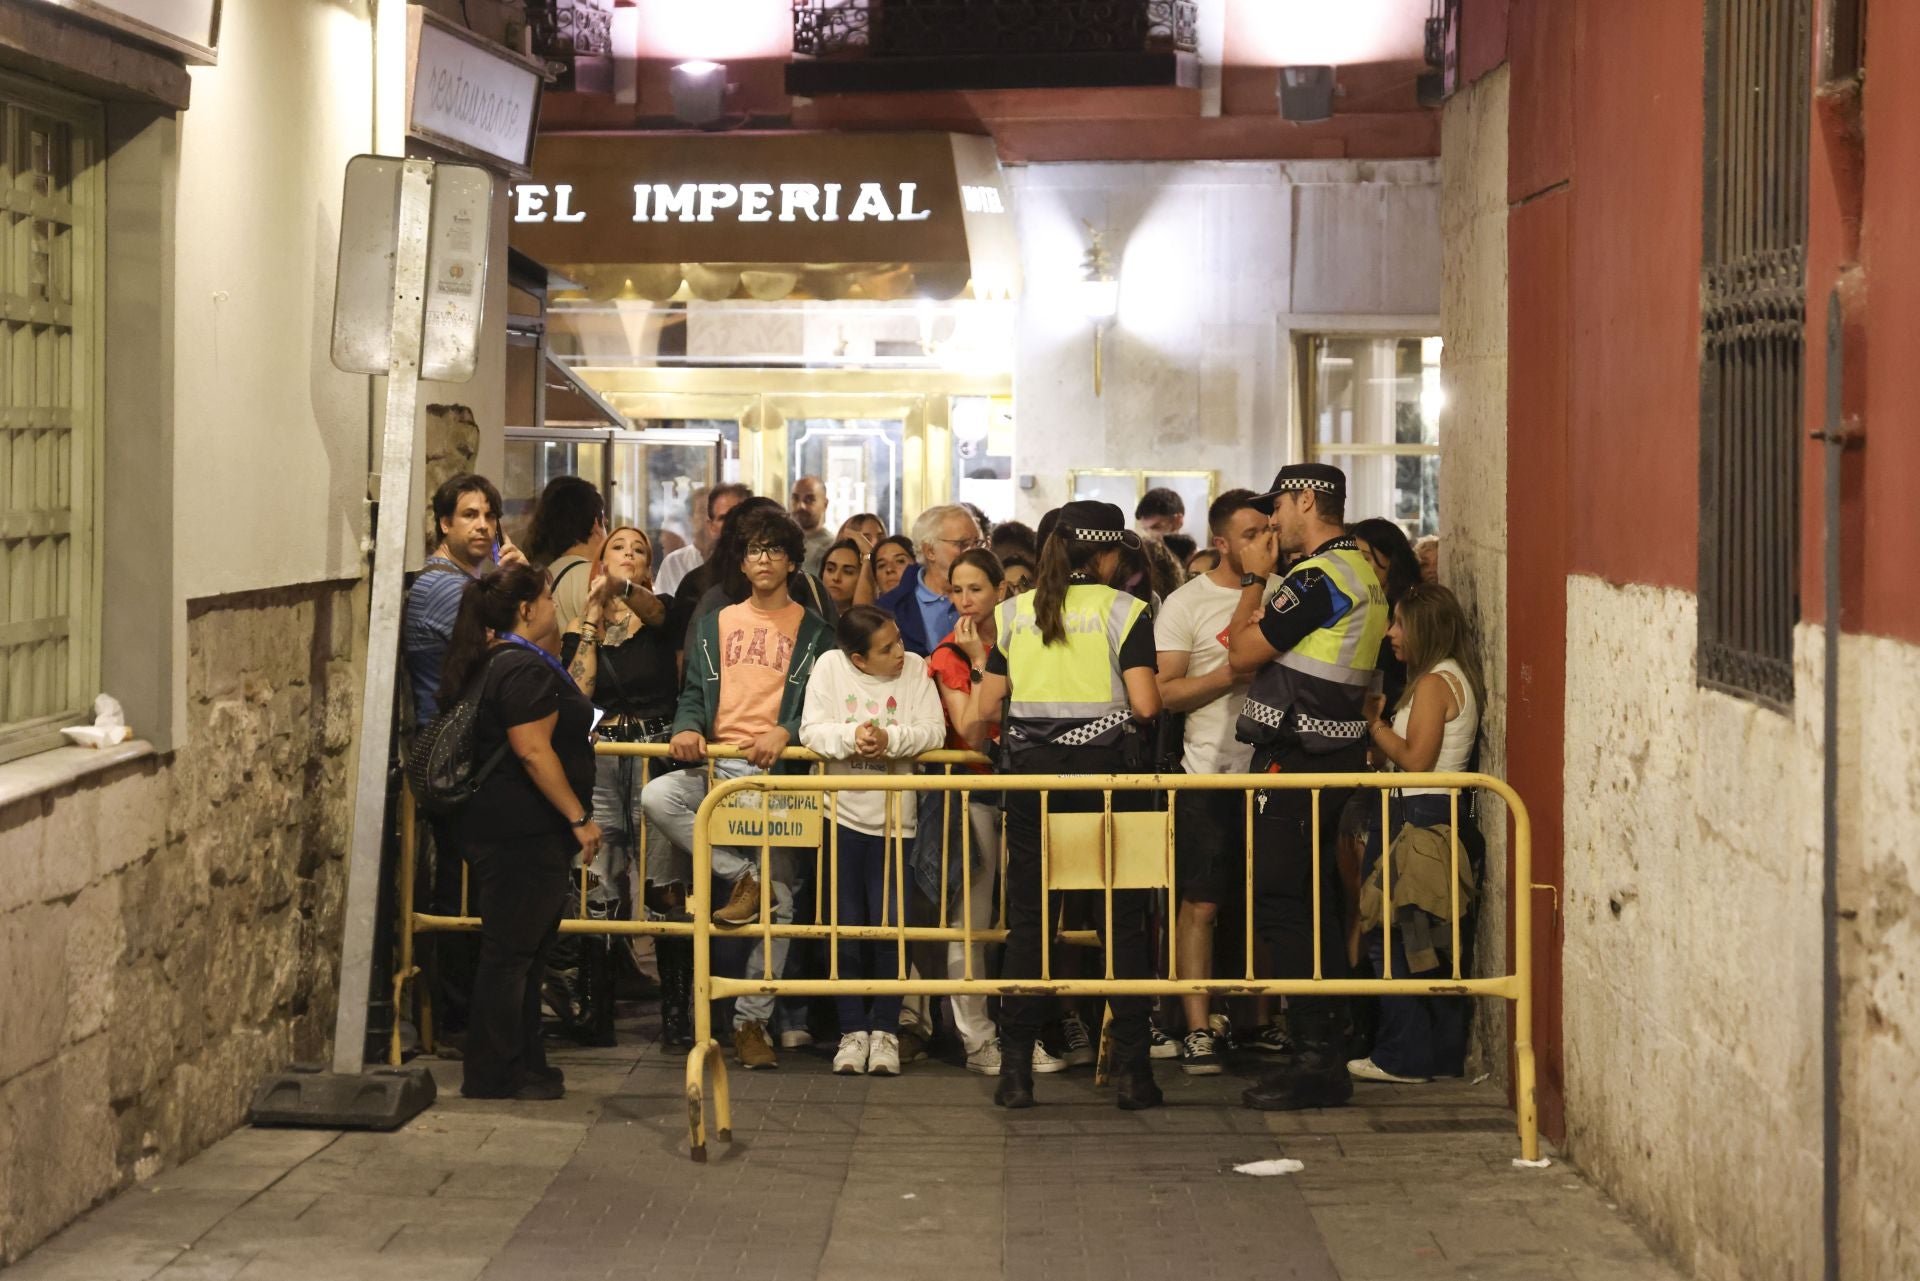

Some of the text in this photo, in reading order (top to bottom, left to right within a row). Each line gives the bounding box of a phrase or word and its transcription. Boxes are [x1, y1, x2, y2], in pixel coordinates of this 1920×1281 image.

[508, 183, 931, 222] EL IMPERIAL
[1015, 606, 1102, 635] PCÍA
[724, 627, 795, 673] GAP
[759, 794, 818, 810] UNICIPAL
